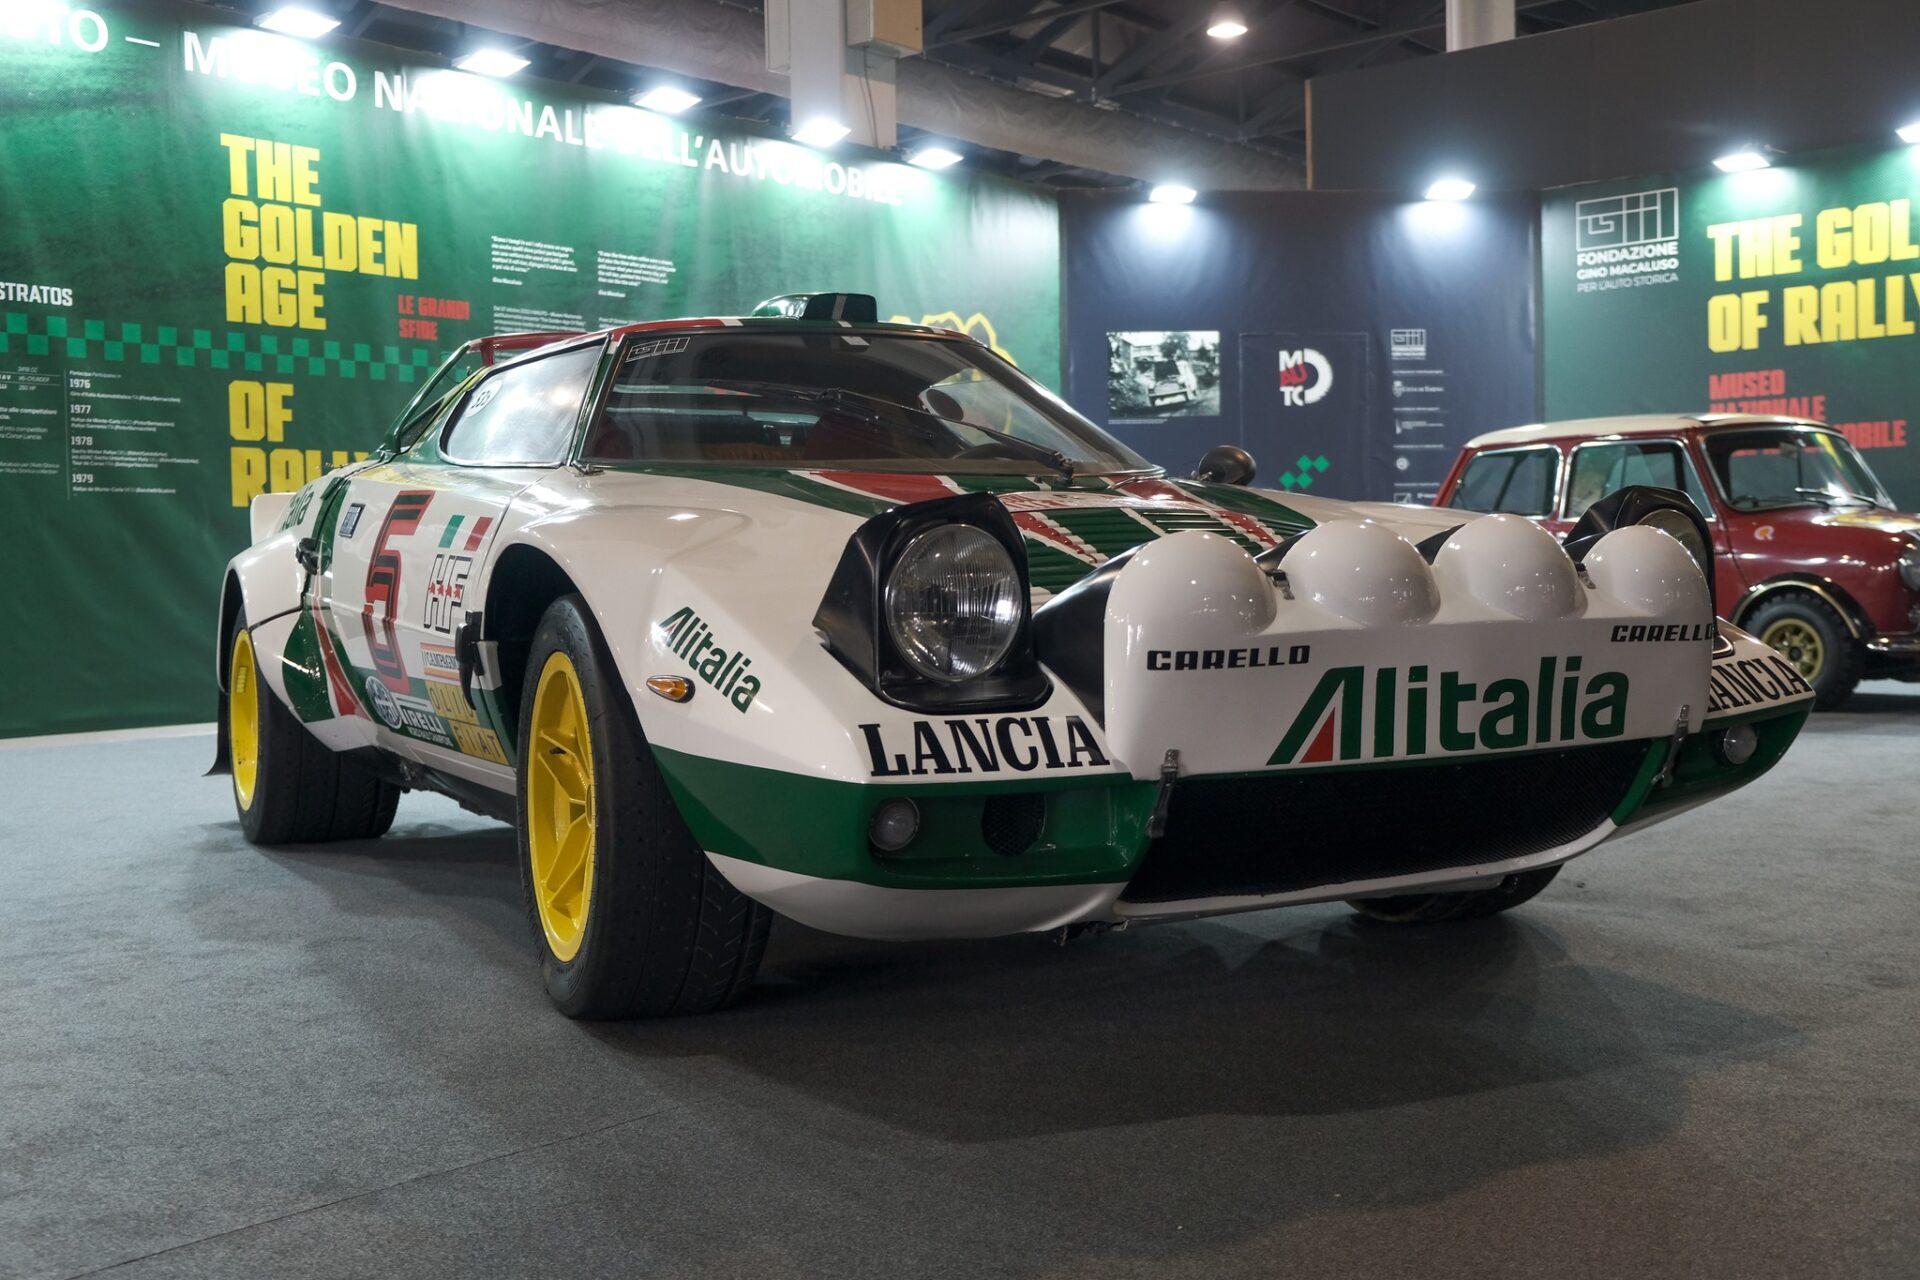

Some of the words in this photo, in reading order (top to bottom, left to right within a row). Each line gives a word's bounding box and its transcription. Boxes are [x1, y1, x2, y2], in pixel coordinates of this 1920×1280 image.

[183, 31, 357, 101] MEO
[374, 71, 606, 149] NAONALE
[618, 130, 904, 206] LL'AUTOMOBILE
[220, 133, 321, 206] THE
[222, 198, 418, 279] GOLDEN
[1577, 241, 1679, 267] FONDAZIONE
[1707, 213, 1803, 282] THE
[1816, 198, 1920, 270] GOL
[0, 281, 73, 307] STRATOS
[224, 262, 326, 330] AGE
[1577, 267, 1608, 280] GINO
[1610, 258, 1679, 277] MACALUSO
[398, 295, 415, 314] LE
[418, 297, 470, 320] GRANDI
[1708, 290, 1769, 353] OF
[69, 378, 91, 389] 1976
[70, 404, 91, 414] 1977
[228, 380, 294, 442] OF
[1709, 369, 1785, 400] MUSEO
[71, 436, 93, 446] 1978
[72, 473, 94, 484] 1979
[657, 606, 762, 714] Alitalia
[1147, 645, 1312, 672] CARELLO
[1707, 655, 1813, 713] ANCIA
[1266, 654, 1630, 766] Alitalia
[859, 716, 1111, 777] LANCIA
